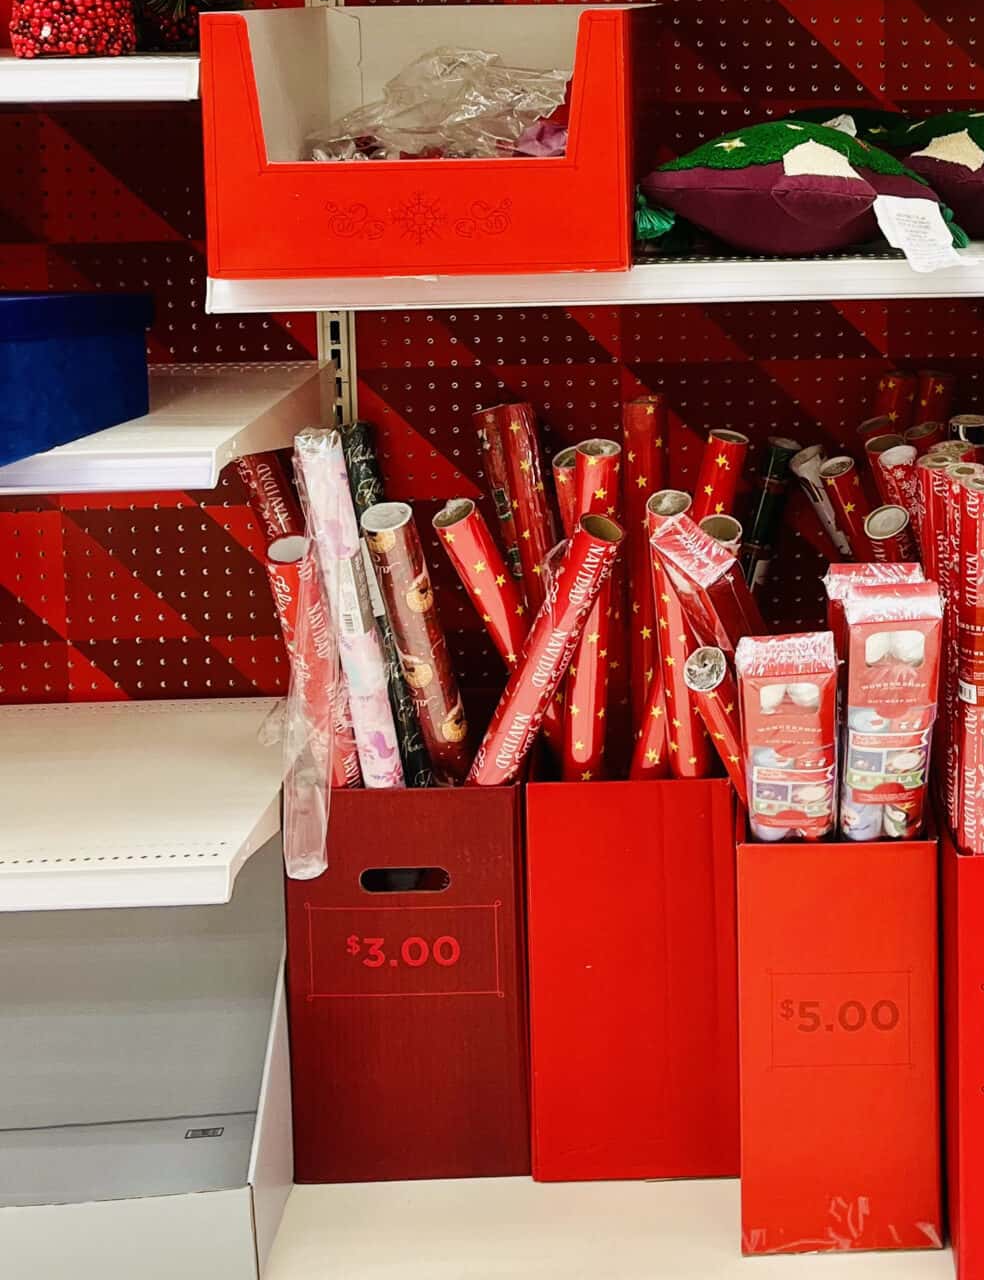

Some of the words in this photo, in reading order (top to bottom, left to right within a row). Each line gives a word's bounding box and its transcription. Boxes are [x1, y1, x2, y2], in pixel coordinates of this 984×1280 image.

[568, 543, 605, 606] NAVIDAD
[965, 552, 978, 607] NAVID
[308, 602, 330, 659] NAVIDAD
[531, 628, 568, 688] NAVIDAD
[495, 712, 530, 770] NAVIDAD
[964, 766, 977, 839] NAVIDAD
[346, 934, 461, 969] $3.00
[779, 998, 900, 1034] $5.00
